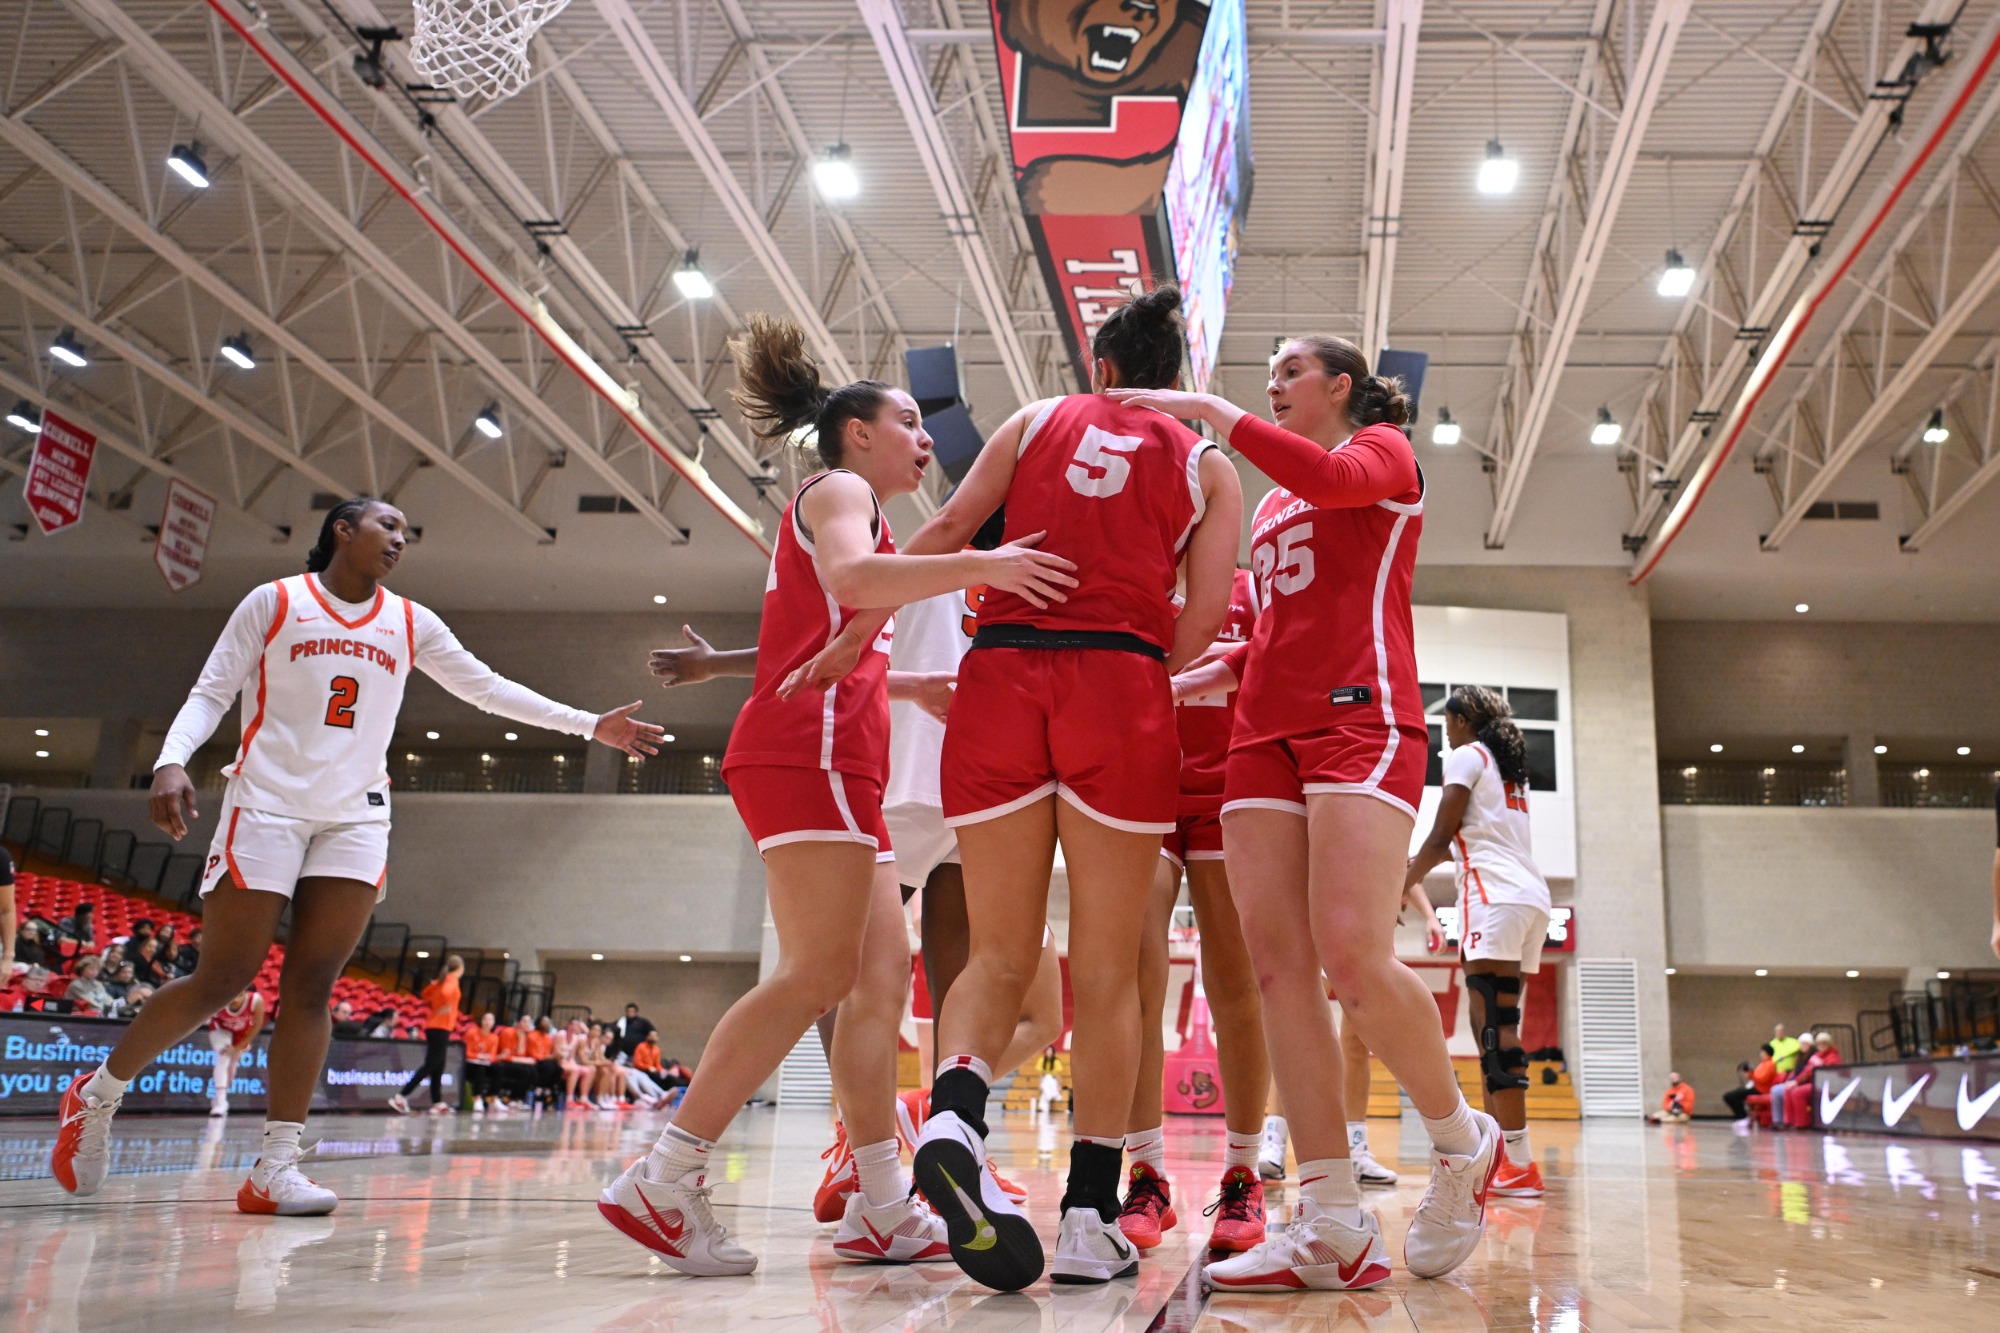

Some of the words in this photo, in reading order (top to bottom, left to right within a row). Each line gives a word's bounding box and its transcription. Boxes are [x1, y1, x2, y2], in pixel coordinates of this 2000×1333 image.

[43, 421, 91, 459] CORNELL
[1065, 423, 1144, 498] 5
[1252, 521, 1316, 610] 25
[290, 638, 396, 676] PRINCETON
[324, 675, 359, 729] 2
[1470, 931, 1482, 950] P
[5, 1034, 114, 1062] Busines
[0, 1073, 51, 1098] you
[139, 1069, 167, 1093] of
[168, 1070, 204, 1093] the
[206, 1077, 267, 1100] gme.
